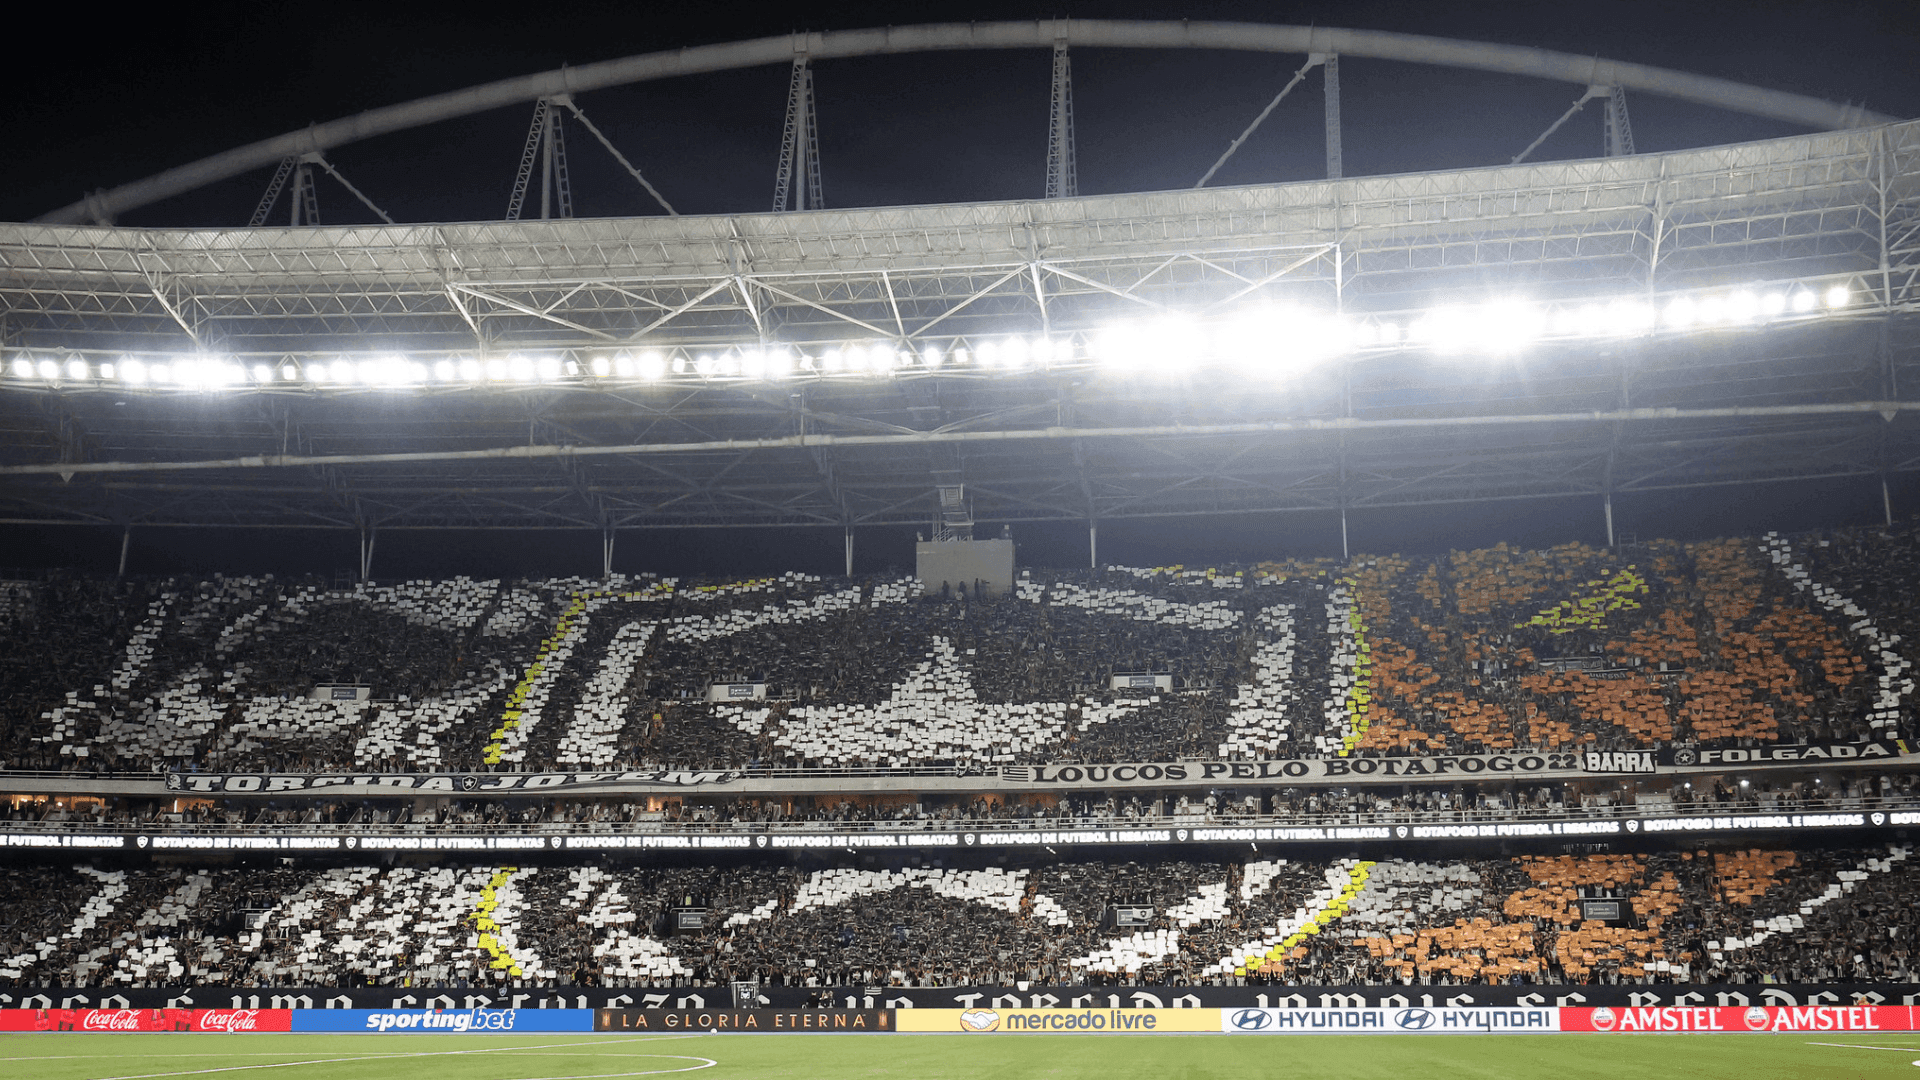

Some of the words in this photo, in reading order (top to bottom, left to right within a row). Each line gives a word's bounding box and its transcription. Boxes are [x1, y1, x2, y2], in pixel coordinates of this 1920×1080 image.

[1586, 752, 1654, 772] BARRA
[1700, 743, 1890, 764] FOLGADA
[1032, 765, 1188, 782] LOUCOS
[1201, 761, 1310, 779] PELO
[1322, 756, 1545, 777] BOTAFOGO
[1548, 754, 1578, 770] 22
[186, 776, 454, 791] TORCIDA
[479, 771, 725, 789] JOVEM
[1413, 825, 1479, 838] BOTAFOGO
[1479, 824, 1497, 837] DE
[1497, 823, 1553, 836] FUTEBOL
[1563, 821, 1620, 834] REGATAS
[1644, 817, 1714, 832] BOTAFOGO
[1714, 817, 1733, 829] DE
[1733, 815, 1792, 829] FUTEBOL
[1803, 814, 1865, 827] REGATAS
[9, 835, 62, 847] FUTEBOL
[72, 836, 124, 848] REGATAS
[153, 836, 214, 849] BOTAFOGO
[214, 837, 230, 849] DE
[231, 837, 280, 849] FUTEBOL
[290, 837, 340, 849] REGATAS
[567, 836, 626, 848] BOTAFOGO
[627, 836, 642, 848] DE
[643, 836, 692, 848] FUTEBOL
[701, 836, 751, 848] REGATAS
[772, 835, 832, 848] BOTAFOGO
[832, 835, 848, 847] DE
[849, 835, 899, 847] FUTEBOL
[908, 834, 959, 846] REGATAS
[980, 832, 1041, 845] BOTAFOGO
[1042, 832, 1058, 844] DE
[1058, 831, 1109, 844] FUTEBOL
[1119, 830, 1171, 842] REGATAS
[1193, 828, 1256, 841] BOTAFOGO
[1256, 828, 1273, 840] DE
[1274, 828, 1327, 840] FUTEBOL
[1336, 827, 1391, 839] REGATAS
[361, 837, 421, 849] BOTAFOGO
[421, 837, 437, 849] DE
[437, 837, 487, 849] FUTEBOL
[496, 837, 546, 849] REGATAS
[84, 1009, 141, 1030] Coca-Cola
[201, 1009, 259, 1030] Coca-Cola
[366, 1009, 516, 1031] sportingbet
[622, 1014, 648, 1027] LA
[665, 1013, 757, 1028] GLORIA
[776, 1014, 866, 1027] ETERNA
[1007, 1010, 1106, 1030] mercado
[1110, 1010, 1157, 1030] livre
[1279, 1011, 1384, 1027] HYUNDAI
[1442, 1011, 1550, 1027] HYUNDAI
[1619, 1008, 1724, 1031] AMSTEL
[1773, 1007, 1880, 1031] AMSTEL
